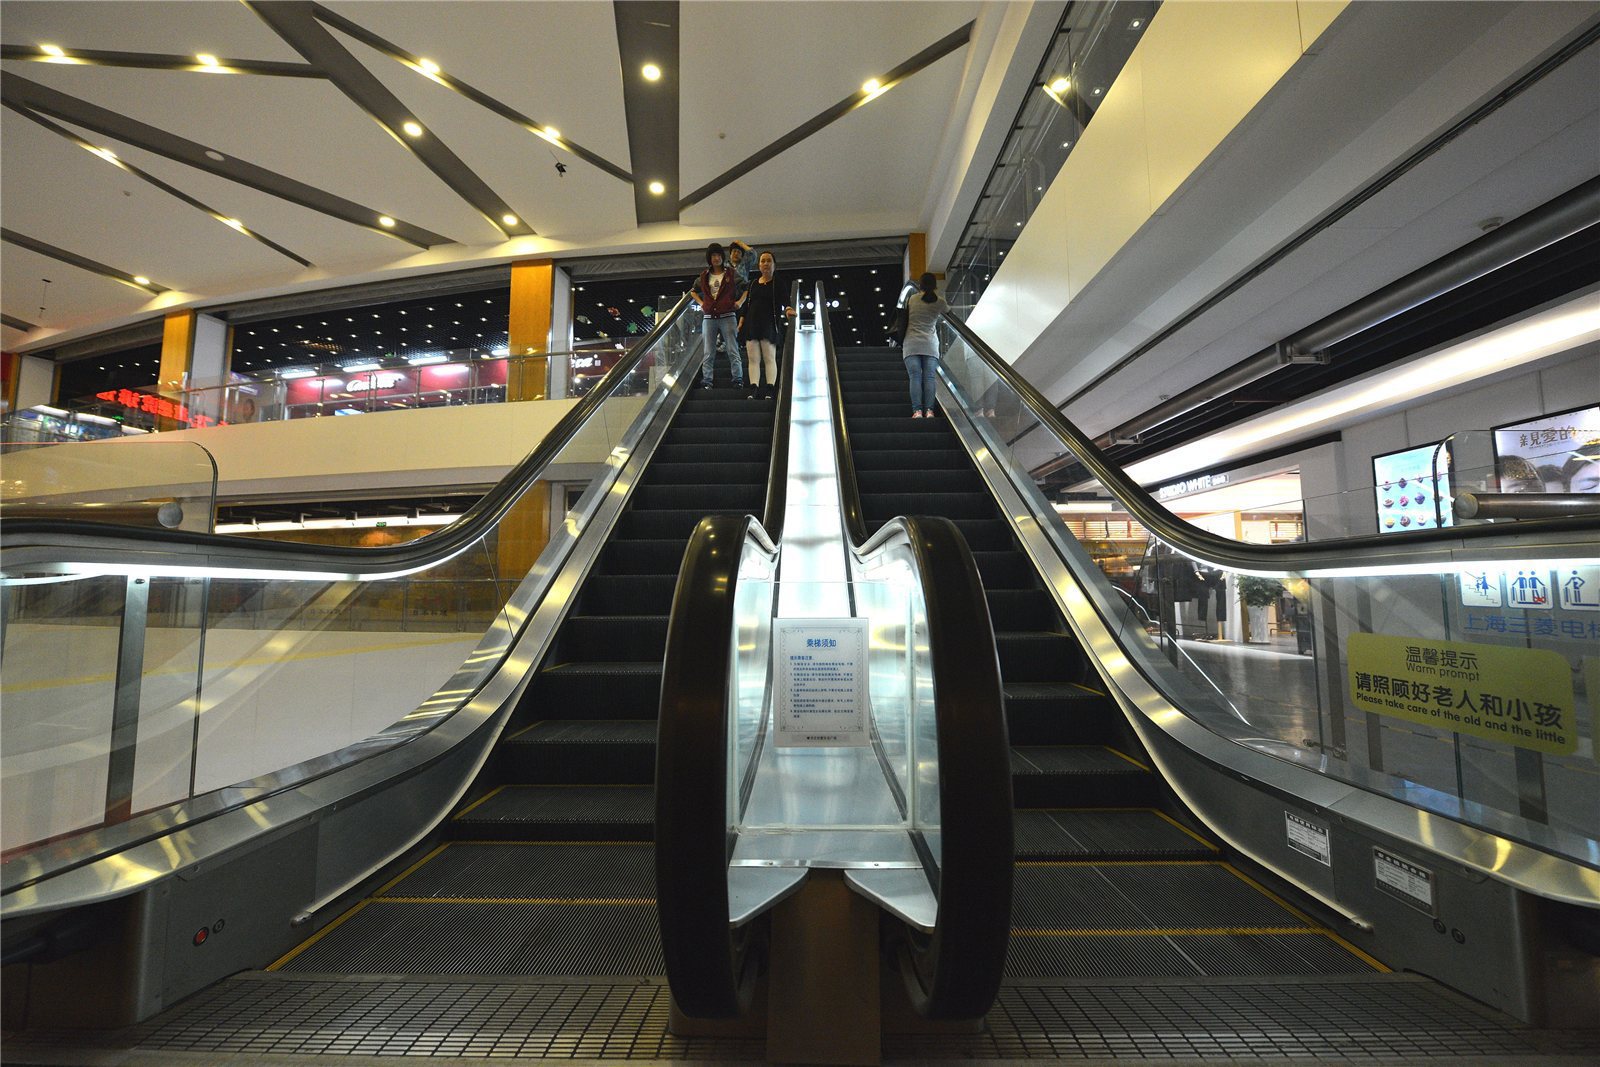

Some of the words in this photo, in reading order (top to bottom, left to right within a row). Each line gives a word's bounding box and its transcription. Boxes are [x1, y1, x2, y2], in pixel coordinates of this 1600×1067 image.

[1519, 425, 1577, 448] 親愛的
[1187, 475, 1211, 491] WHITE
[806, 638, 837, 648] 乘梯须知
[1405, 646, 1478, 670] 温馨提示
[1406, 662, 1436, 675] Warm
[1440, 669, 1480, 681] prompt
[1355, 671, 1563, 729] 请照顾好老人和小孩
[1356, 692, 1383, 705] Please
[1385, 699, 1404, 710] take
[1407, 704, 1428, 715] care
[1430, 709, 1441, 717] of
[1443, 711, 1461, 722] the
[1464, 713, 1481, 726] old
[1485, 721, 1507, 732] and
[1511, 724, 1532, 737] the
[1536, 729, 1565, 744] little
